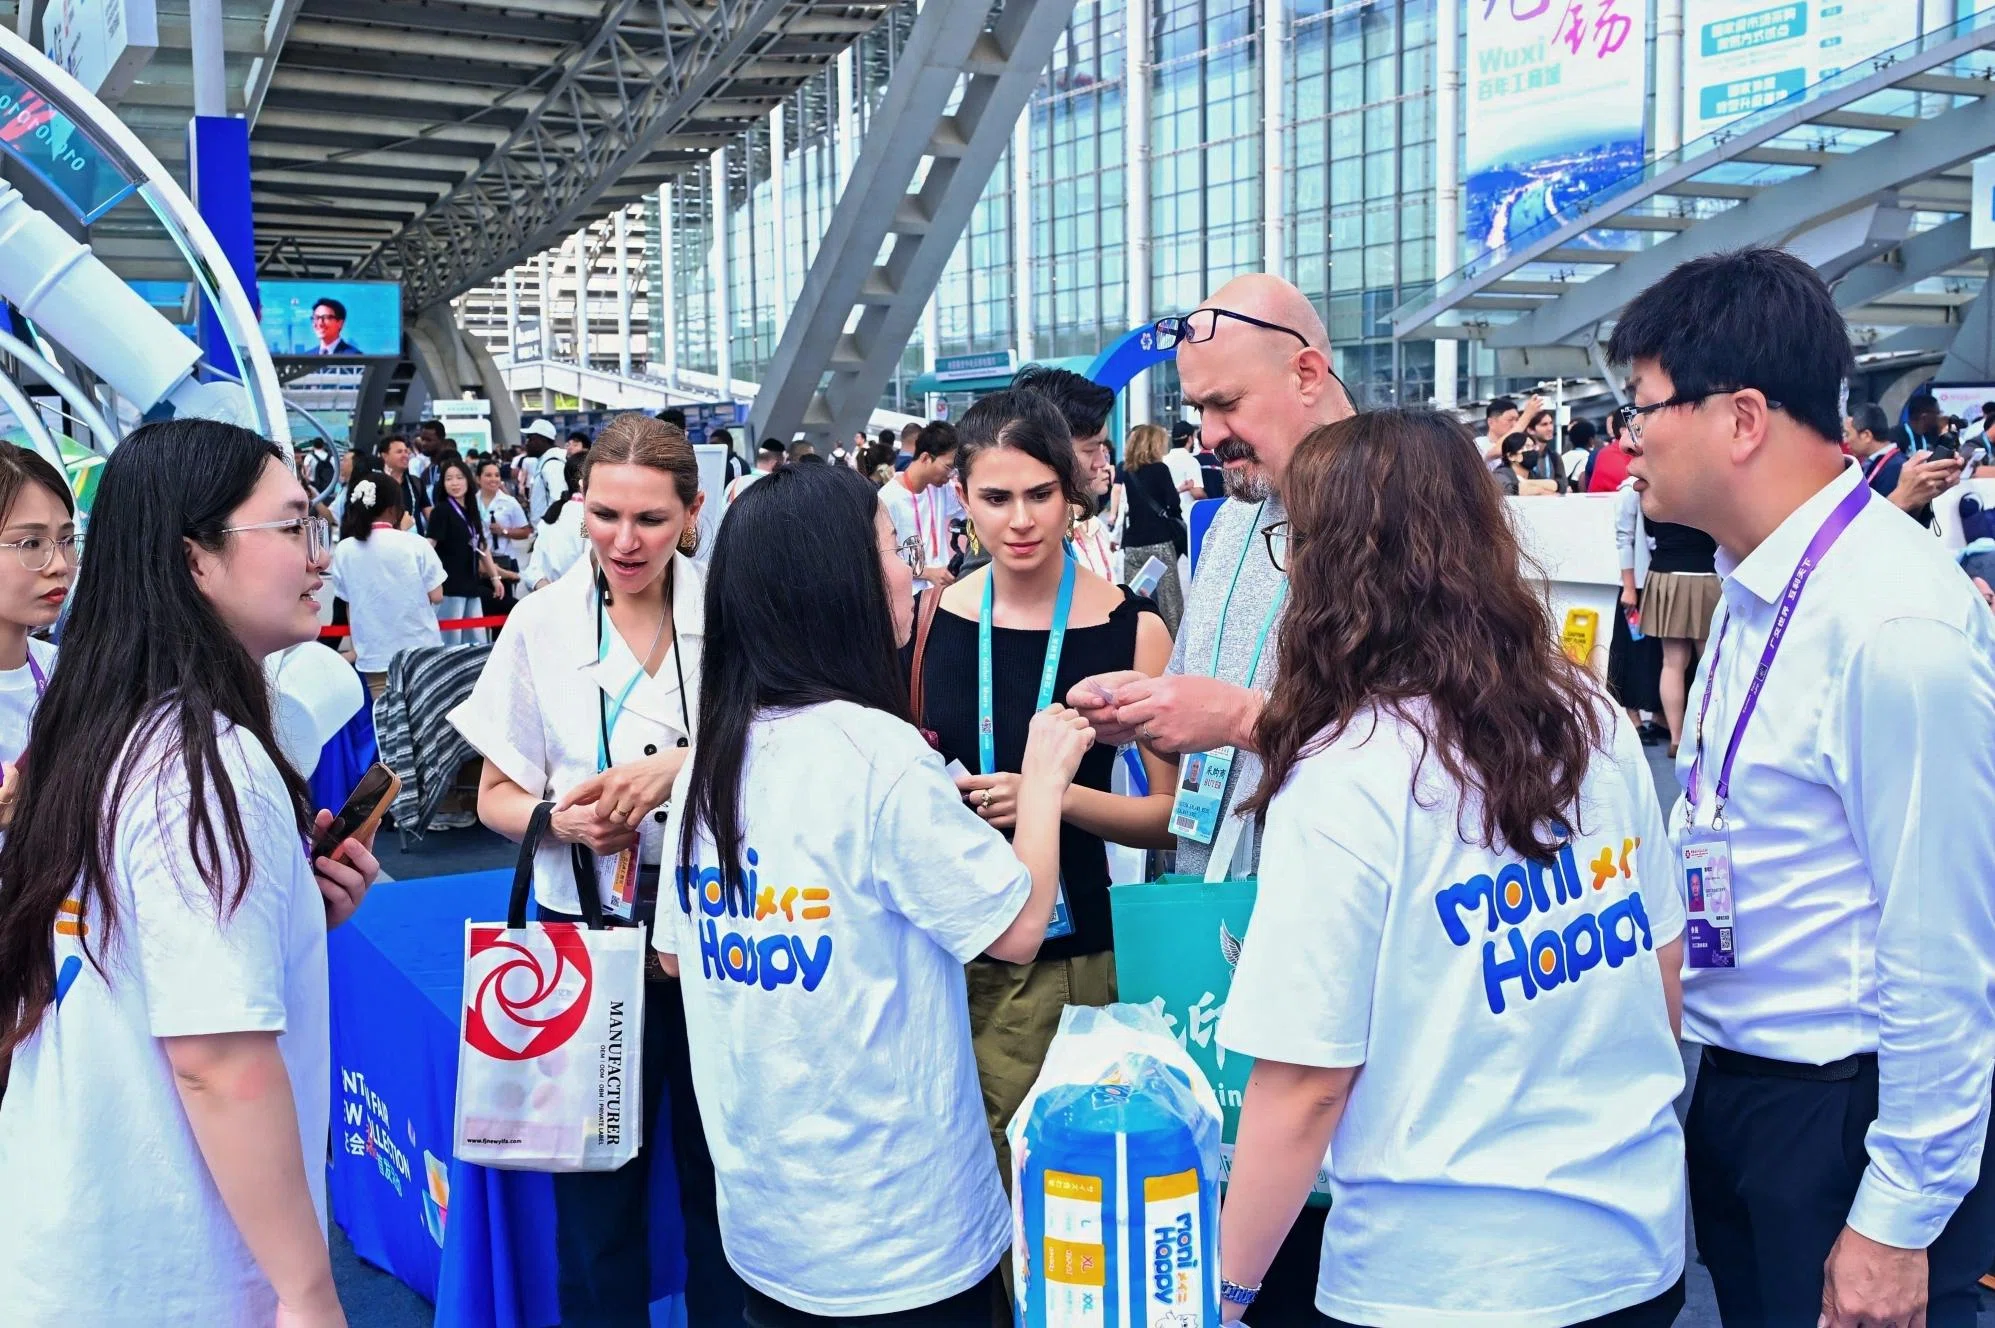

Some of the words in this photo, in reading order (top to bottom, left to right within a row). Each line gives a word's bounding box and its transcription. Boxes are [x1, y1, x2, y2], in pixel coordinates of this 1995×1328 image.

[1478, 36, 1545, 74] Wuxi
[1769, 605, 1790, 649] 广交世界
[1788, 556, 1812, 601] 互利天下
[1435, 818, 1583, 946] moni
[1590, 837, 1641, 891] メイ
[606, 1000, 624, 1146] MANUFACTURER
[1081, 1255, 1095, 1273] XL
[1154, 1225, 1176, 1306] Happy
[1176, 1212, 1199, 1269] moni
